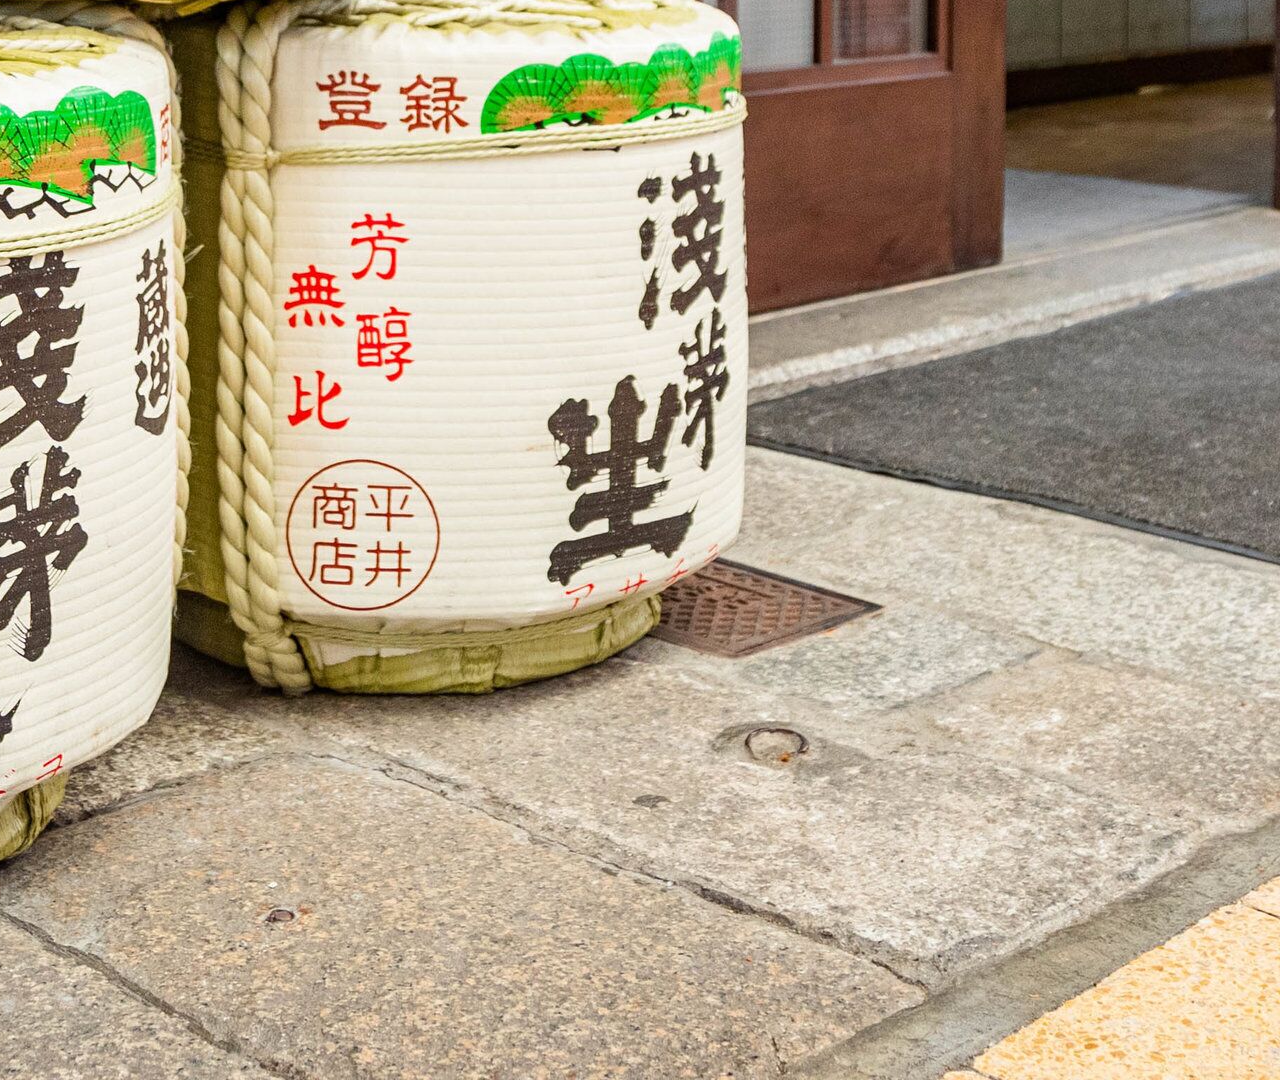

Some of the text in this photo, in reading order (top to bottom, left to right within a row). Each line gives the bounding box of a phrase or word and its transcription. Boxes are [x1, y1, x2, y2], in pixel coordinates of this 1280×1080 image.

[316, 70, 469, 133] 登録
[282, 263, 350, 431] 無比
[350, 212, 414, 383] 芳醇
